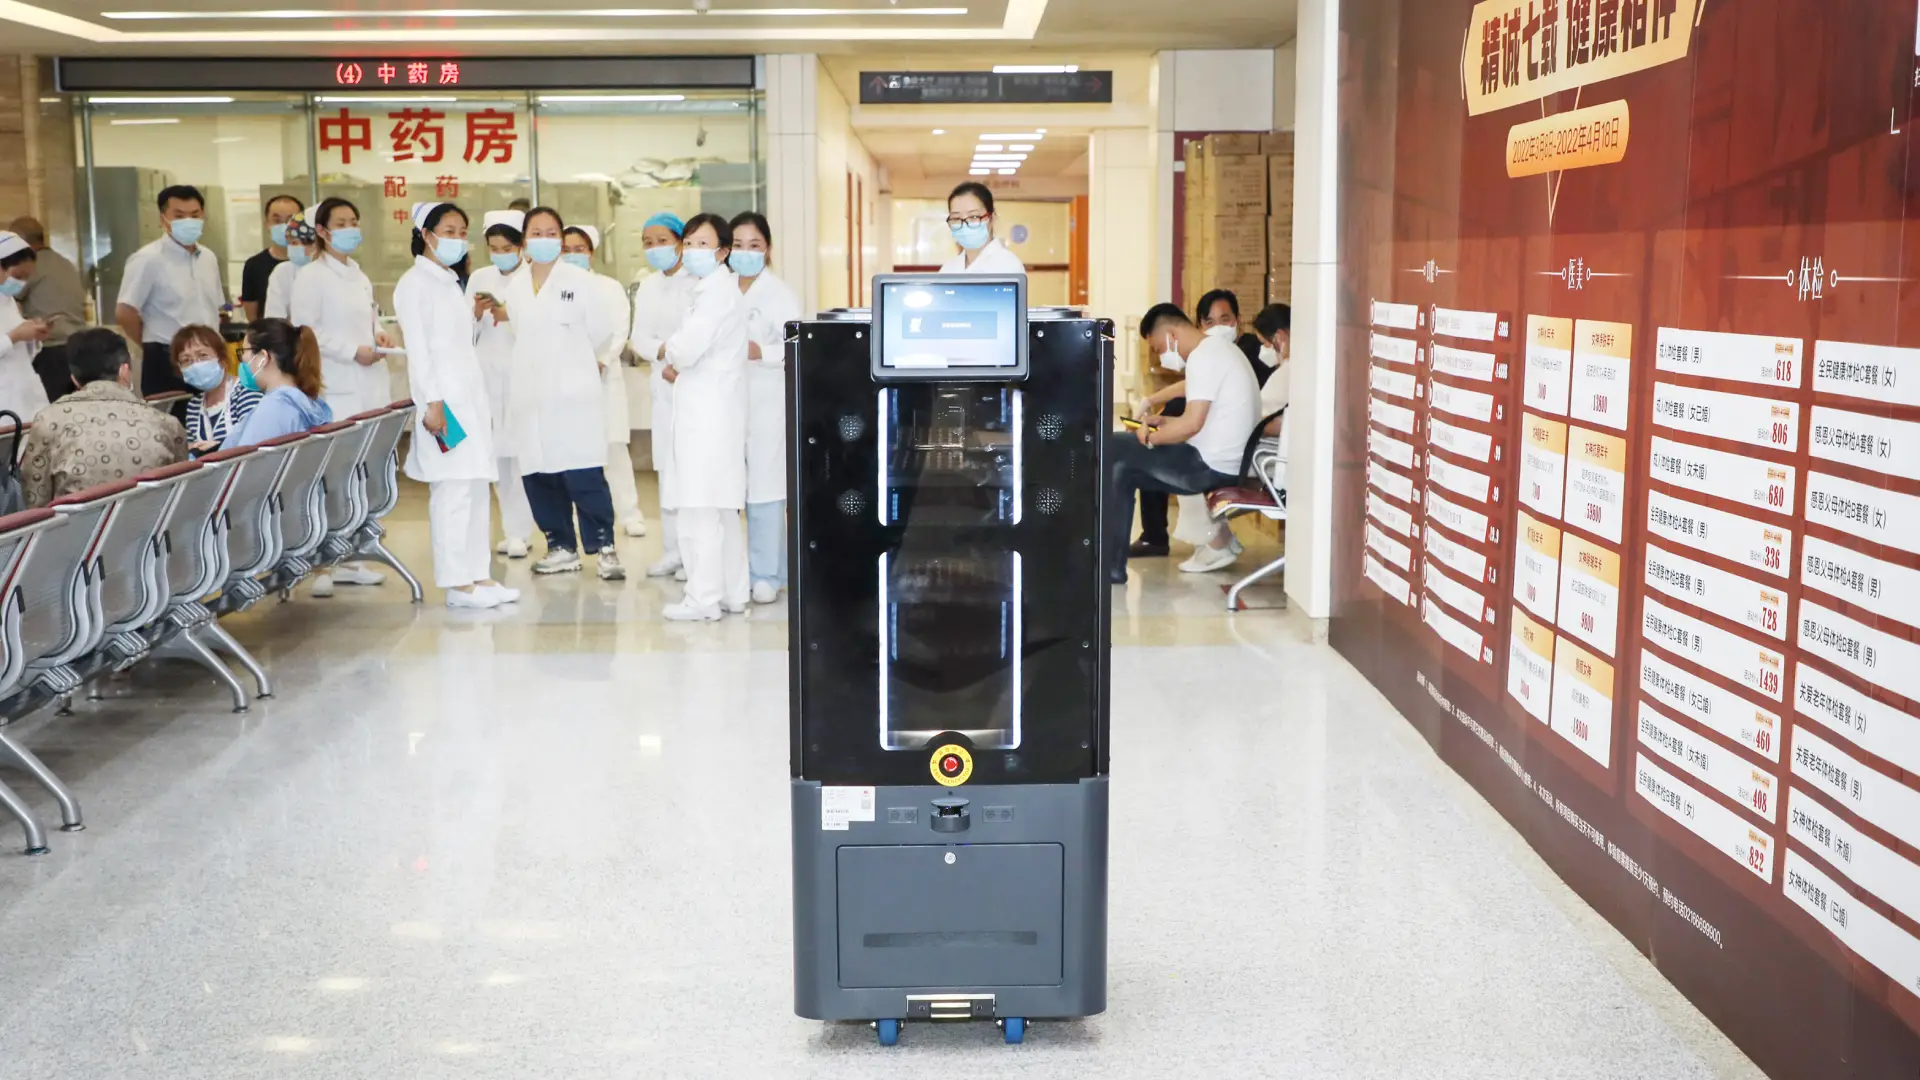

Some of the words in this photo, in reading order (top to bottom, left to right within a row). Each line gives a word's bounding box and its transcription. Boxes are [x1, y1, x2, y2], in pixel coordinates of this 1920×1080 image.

[1480, 0, 1558, 96] 精诚七载
[377, 62, 459, 84] 中药房
[319, 108, 518, 165] 中药房
[384, 175, 459, 198] 配药
[1568, 257, 1583, 290] 医美
[1799, 255, 1824, 302] 体检
[1776, 360, 1792, 382] 618
[1772, 422, 1788, 445] 806
[1768, 484, 1784, 507] 680
[1765, 546, 1780, 570] 336
[1762, 607, 1778, 632] 728
[1759, 668, 1779, 694] 1439
[1755, 730, 1770, 753] 460
[1752, 788, 1767, 814] 408
[1749, 846, 1764, 873] 822
